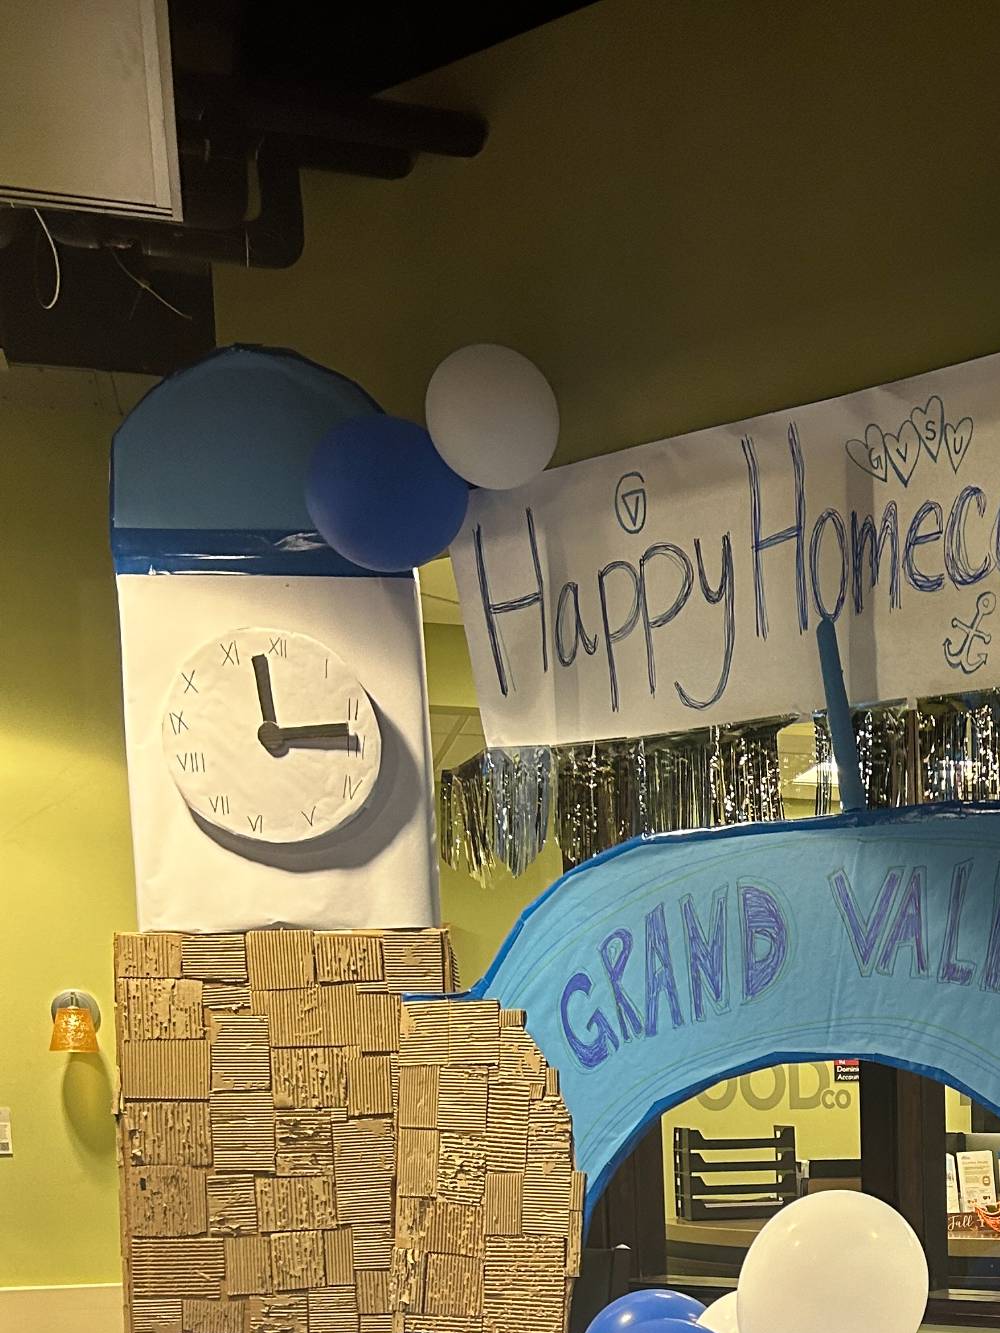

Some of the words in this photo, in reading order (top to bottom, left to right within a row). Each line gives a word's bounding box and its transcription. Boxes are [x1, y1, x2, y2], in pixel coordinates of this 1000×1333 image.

[472, 507, 735, 713] Happy
[220, 640, 240, 665] XI
[268, 637, 287, 658] XII
[181, 669, 199, 694] X
[169, 710, 189, 735] IX
[176, 752, 206, 773] VIII
[342, 774, 363, 800] IV
[209, 795, 230, 815] VII
[301, 806, 317, 826] V
[248, 814, 264, 834] VI
[555, 876, 790, 1073] GRAND
